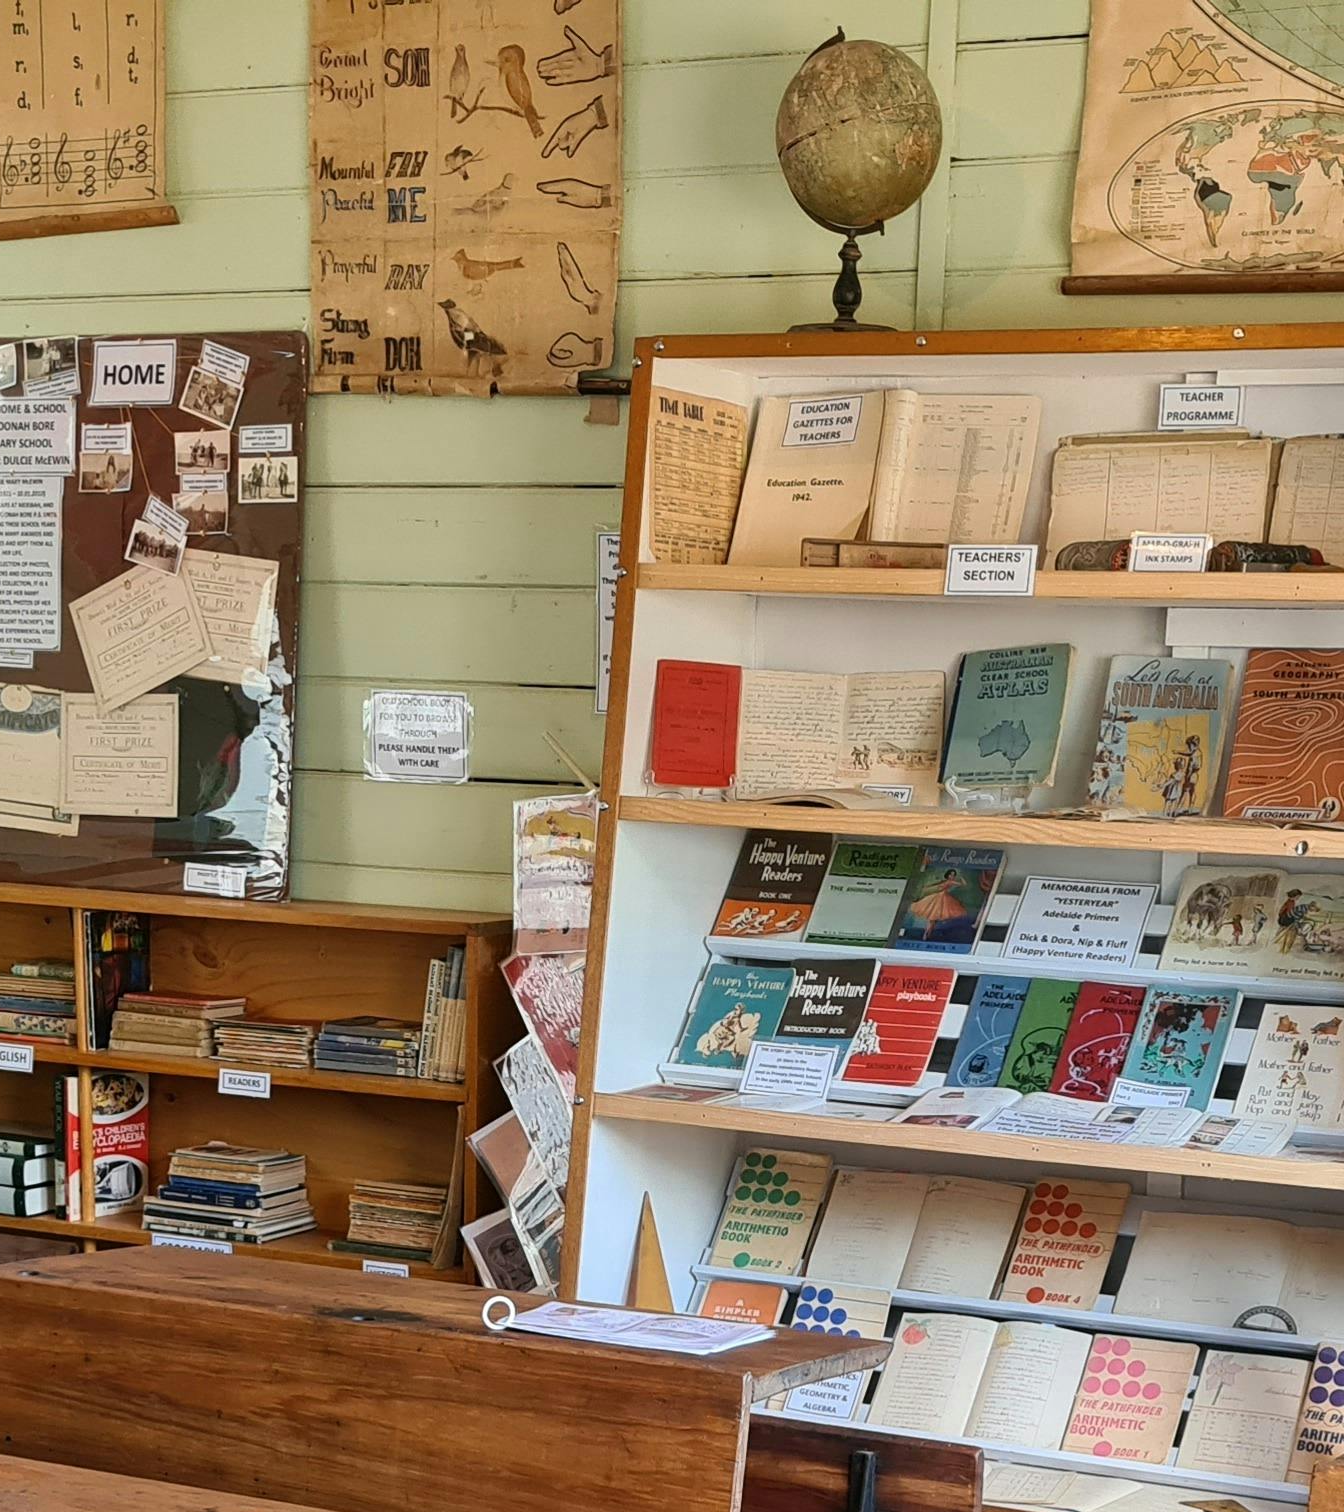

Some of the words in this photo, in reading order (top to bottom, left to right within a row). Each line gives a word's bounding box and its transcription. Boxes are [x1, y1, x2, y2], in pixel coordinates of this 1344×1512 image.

[384, 47, 430, 87] SOH
[384, 150, 428, 178] FAH
[387, 186, 427, 223] ME
[384, 337, 422, 372] DOH
[103, 364, 166, 387] HOME
[1179, 392, 1224, 403] TEACHER
[33, 404, 67, 413] SCHOOL
[659, 396, 679, 416] TIME
[683, 402, 705, 421] TABLE
[801, 402, 851, 414] EDUCATION
[1166, 410, 1234, 422] PROGRAMME
[32, 421, 55, 431] BORE
[793, 417, 833, 429] GAZETTES
[835, 416, 853, 425] FOR
[799, 431, 841, 441] TEACHERS
[19, 439, 53, 448] SCHOOL
[3, 456, 33, 465] DULCIE
[766, 479, 807, 487] Education
[1160, 555, 1193, 564] STAMPS
[963, 570, 1015, 581] SECTION
[981, 672, 1008, 681] CLEAR
[1015, 670, 1049, 679] SCHOOL
[1272, 670, 1341, 680] GEOGRAPHY
[977, 679, 1049, 699] ATLAS
[1253, 690, 1289, 699] SOUTH
[1112, 681, 1152, 708] SOUTH
[1152, 683, 1218, 710] AUSTRALIA
[379, 744, 403, 752] PLEASE
[405, 744, 435, 754] HANDLE
[398, 758, 418, 767] WITH
[421, 759, 439, 768] CARE
[1251, 811, 1312, 820] GEOGRAPHY
[764, 838, 777, 848] The
[749, 844, 784, 867] Happy
[785, 845, 825, 866] Venture
[760, 867, 803, 883] Readers
[1041, 882, 1110, 894] MEMORABELIA
[1112, 887, 1141, 896] FROM
[1042, 910, 1082, 920] Adelaide
[1084, 913, 1119, 922] Primers
[1072, 924, 1080, 932] &
[1019, 933, 1038, 942] Dick
[1041, 934, 1048, 943] &
[1051, 935, 1075, 946] Dora,
[1077, 937, 1094, 949] Nip
[1095, 939, 1103, 947] &
[1107, 939, 1128, 949] Fluff
[1012, 945, 1044, 957] (Happy
[1047, 947, 1083, 959] Venture
[1086, 950, 1126, 963] Readers)
[804, 969, 818, 980] The
[712, 977, 741, 988] HAPPY
[792, 976, 824, 998] Happy
[826, 977, 866, 998] Venture
[896, 991, 937, 1002] playbooks
[983, 991, 1026, 1001] ADELAIDE
[801, 999, 843, 1016] Readers
[1266, 1032, 1296, 1044] Mother
[1312, 1035, 1341, 1047] Father
[1288, 1061, 1306, 1071] and
[1307, 1063, 1334, 1074] Father
[228, 1077, 261, 1088] READERS
[730, 1206, 749, 1216] THE
[751, 1208, 804, 1221] PATHFINDER
[724, 1220, 789, 1237] ARITHMETIC
[721, 1230, 752, 1243] BOOK
[1021, 1237, 1039, 1247] THE
[1042, 1240, 1101, 1254] PATHFINDER
[750, 1258, 773, 1267] BOOK
[774, 1260, 782, 1268] 2
[1015, 1253, 1085, 1270] ARITHMETIC
[1011, 1265, 1045, 1277] BOOK
[1045, 1292, 1071, 1302] BOOK
[1073, 1295, 1081, 1304] 4
[714, 1306, 760, 1316] SIMPLER
[800, 1388, 841, 1400] GEOMETRY
[803, 1403, 837, 1413] ALGEBRA
[1079, 1399, 1098, 1409] THE
[1101, 1402, 1163, 1416] PATHFINDER
[1305, 1410, 1327, 1421] THE
[1073, 1413, 1146, 1431] ARITHMETIC
[1069, 1424, 1105, 1437] BOOK
[1112, 1448, 1140, 1457] BOOK
[1297, 1440, 1334, 1455] BOOK
